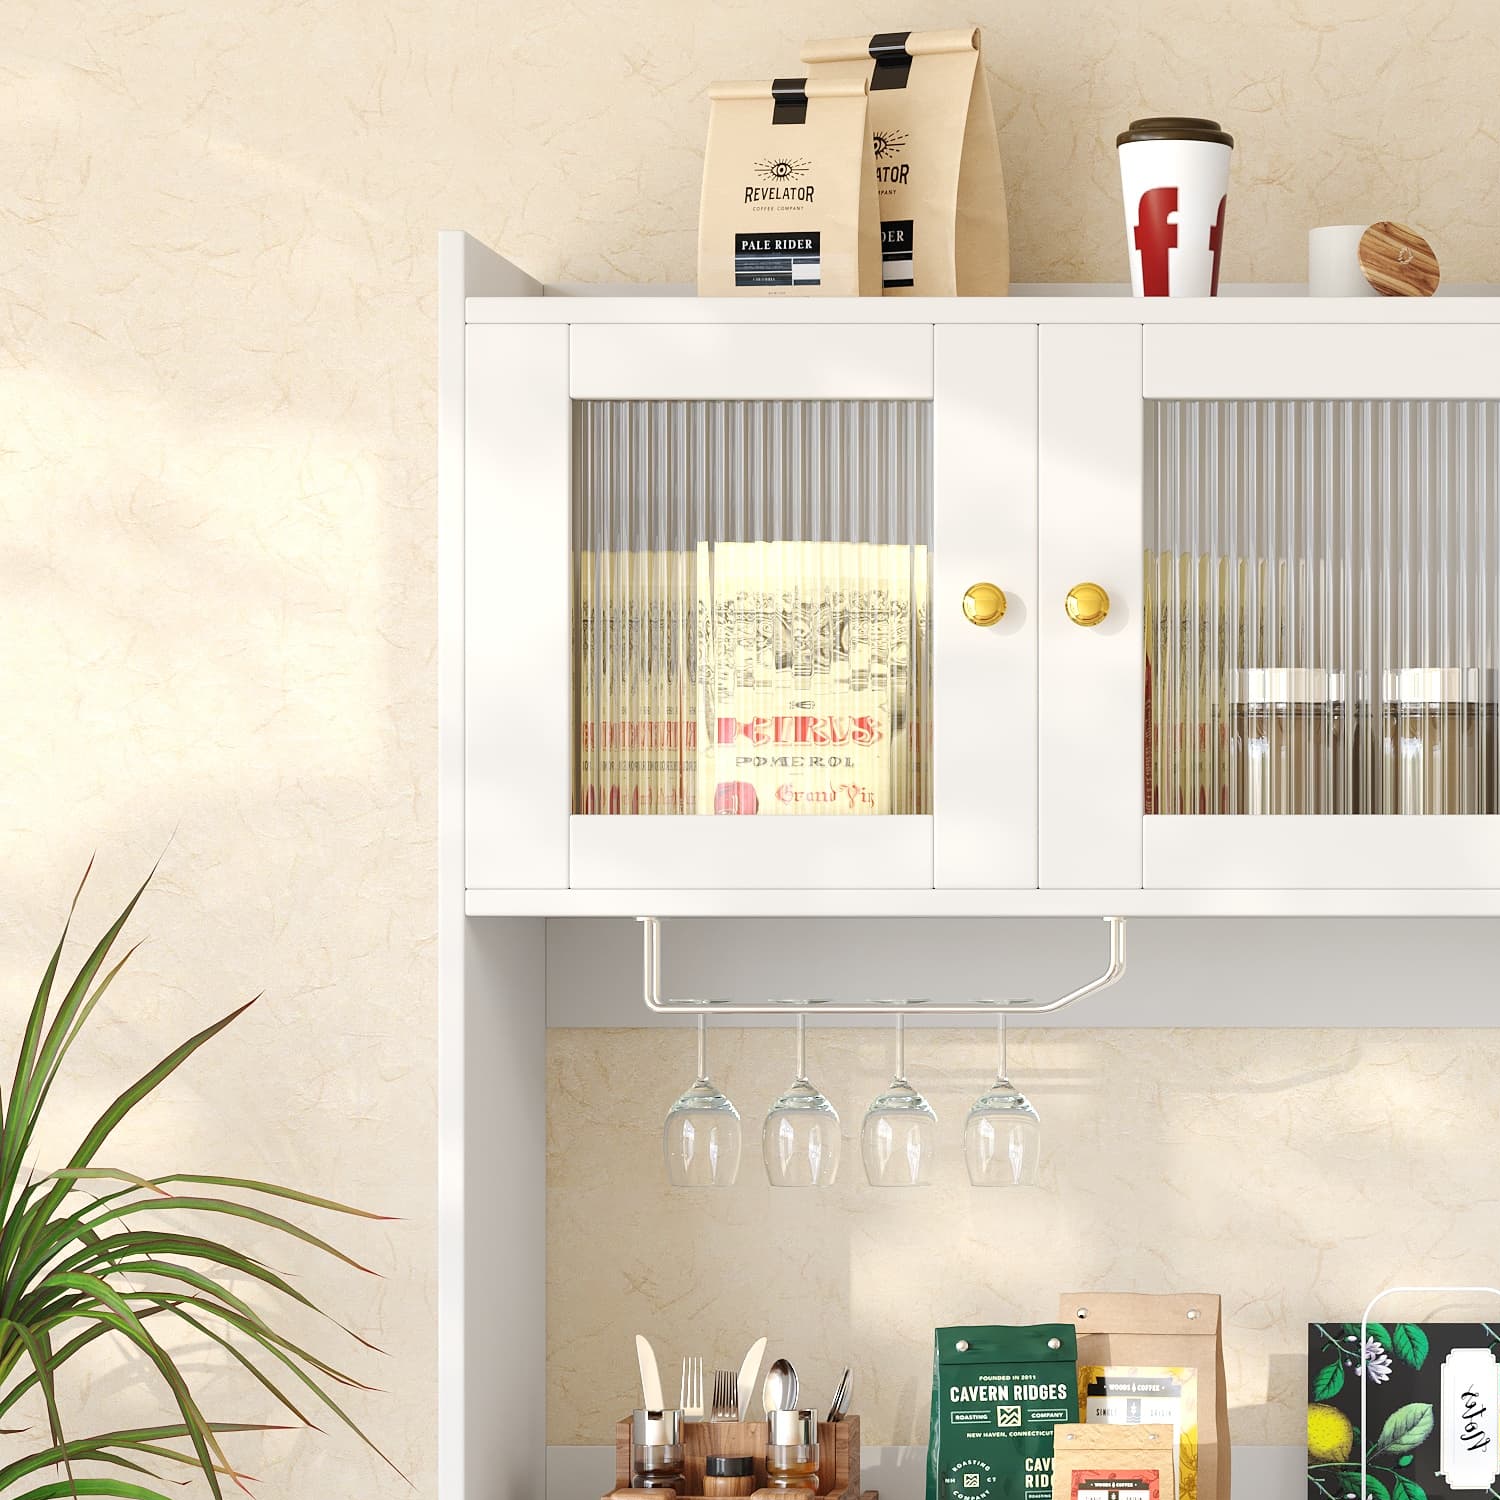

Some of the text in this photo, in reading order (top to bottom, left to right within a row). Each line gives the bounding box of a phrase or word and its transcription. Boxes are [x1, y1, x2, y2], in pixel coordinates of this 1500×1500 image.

[745, 186, 814, 203] REVELATOR
[742, 239, 813, 250] PALE RIDER
[736, 756, 855, 768] POMEROL
[775, 779, 837, 806] Grand
[950, 1384, 1067, 1402] CAVERN RIDGES
[1137, 1384, 1160, 1392] COFFEE
[1096, 1408, 1117, 1416] SINGLE
